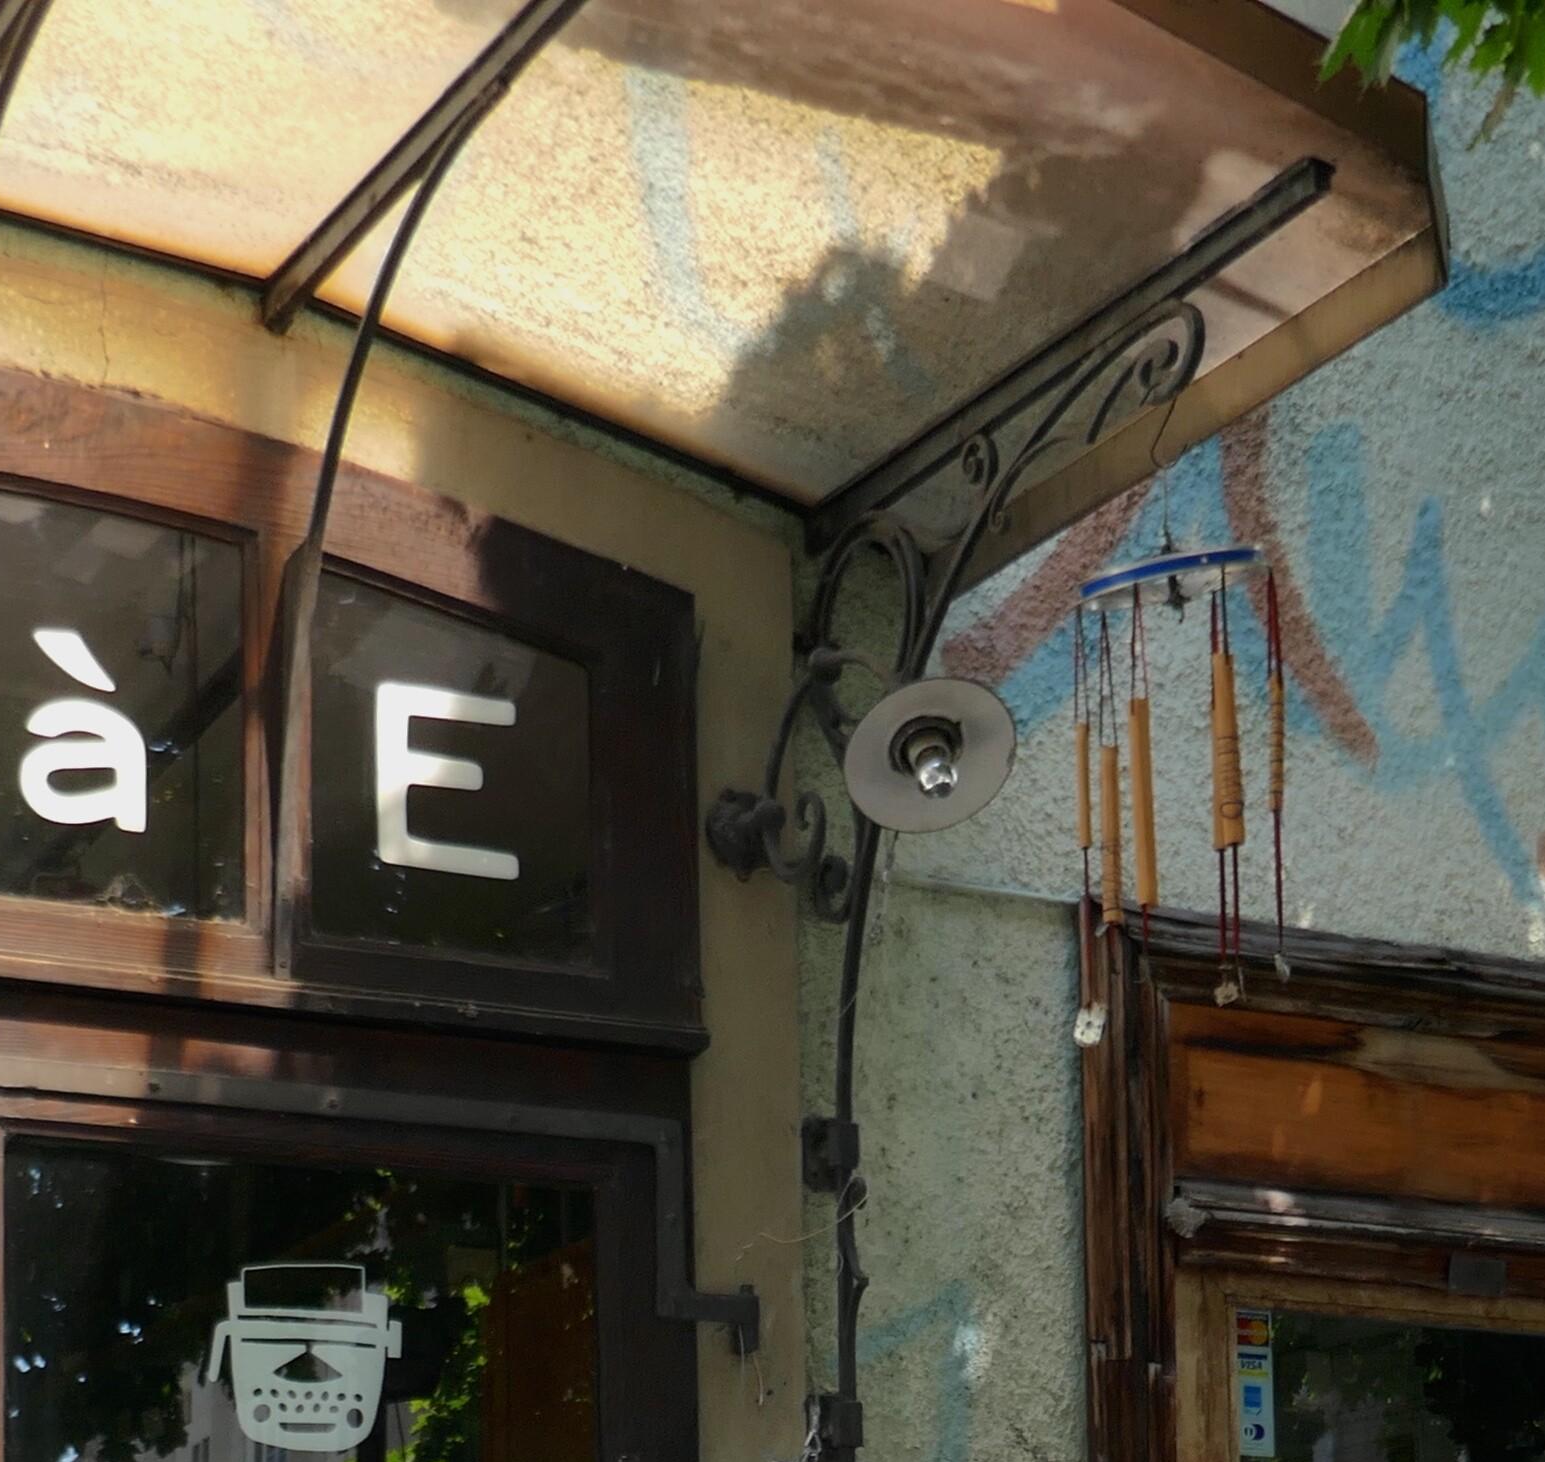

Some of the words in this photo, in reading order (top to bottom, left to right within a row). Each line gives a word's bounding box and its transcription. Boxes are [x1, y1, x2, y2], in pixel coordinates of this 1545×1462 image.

[18, 629, 148, 833] à
[375, 682, 519, 880] E
[1240, 1360, 1262, 1370] VISA
